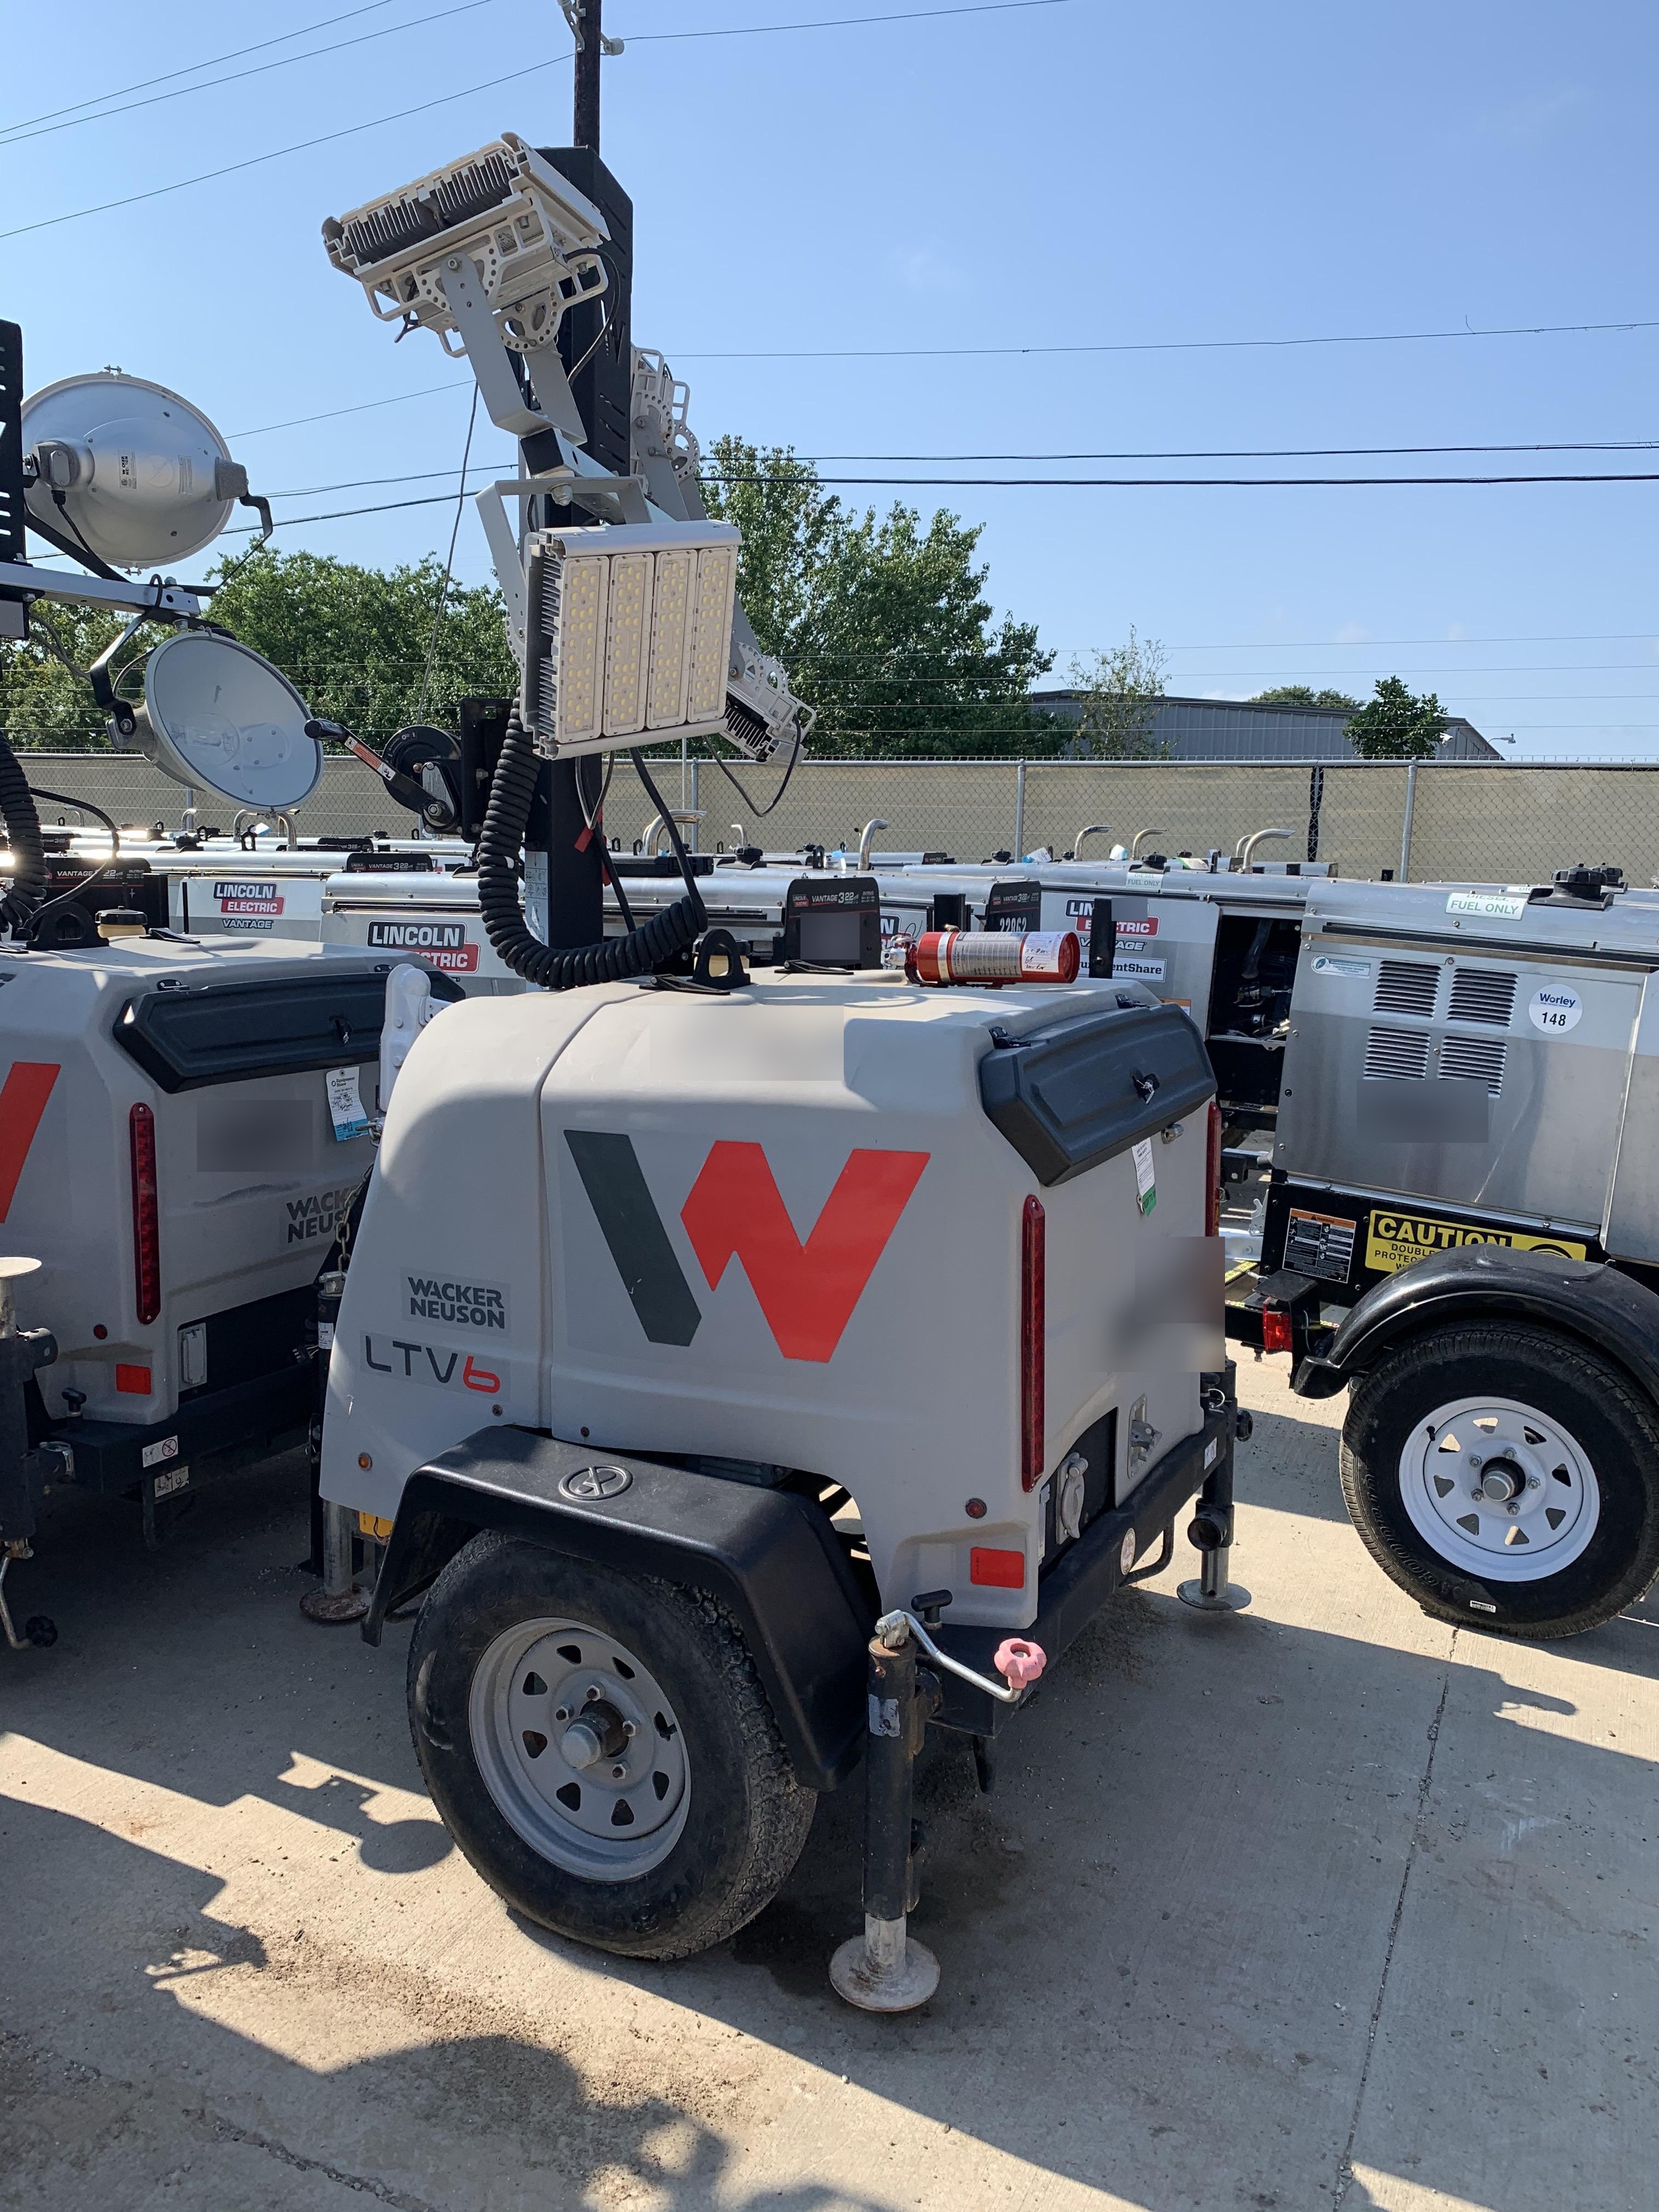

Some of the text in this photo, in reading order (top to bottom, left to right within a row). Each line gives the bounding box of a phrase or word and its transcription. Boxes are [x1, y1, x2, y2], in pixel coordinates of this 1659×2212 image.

[216, 884, 273, 898] LINCOLN
[838, 892, 854, 904] 322
[227, 901, 278, 912] ELECTRIC
[1451, 900, 1519, 915] FUEL ONLY
[222, 918, 273, 929] VANTAGE
[372, 926, 460, 947] LINCOLN
[1539, 993, 1576, 1008] Worley
[1542, 1012, 1566, 1026] 148
[1378, 1217, 1506, 1248] CAUTION
[408, 1277, 504, 1308] WACKER
[410, 1297, 505, 1329] NEUSON
[365, 1335, 501, 1393] LTV6
